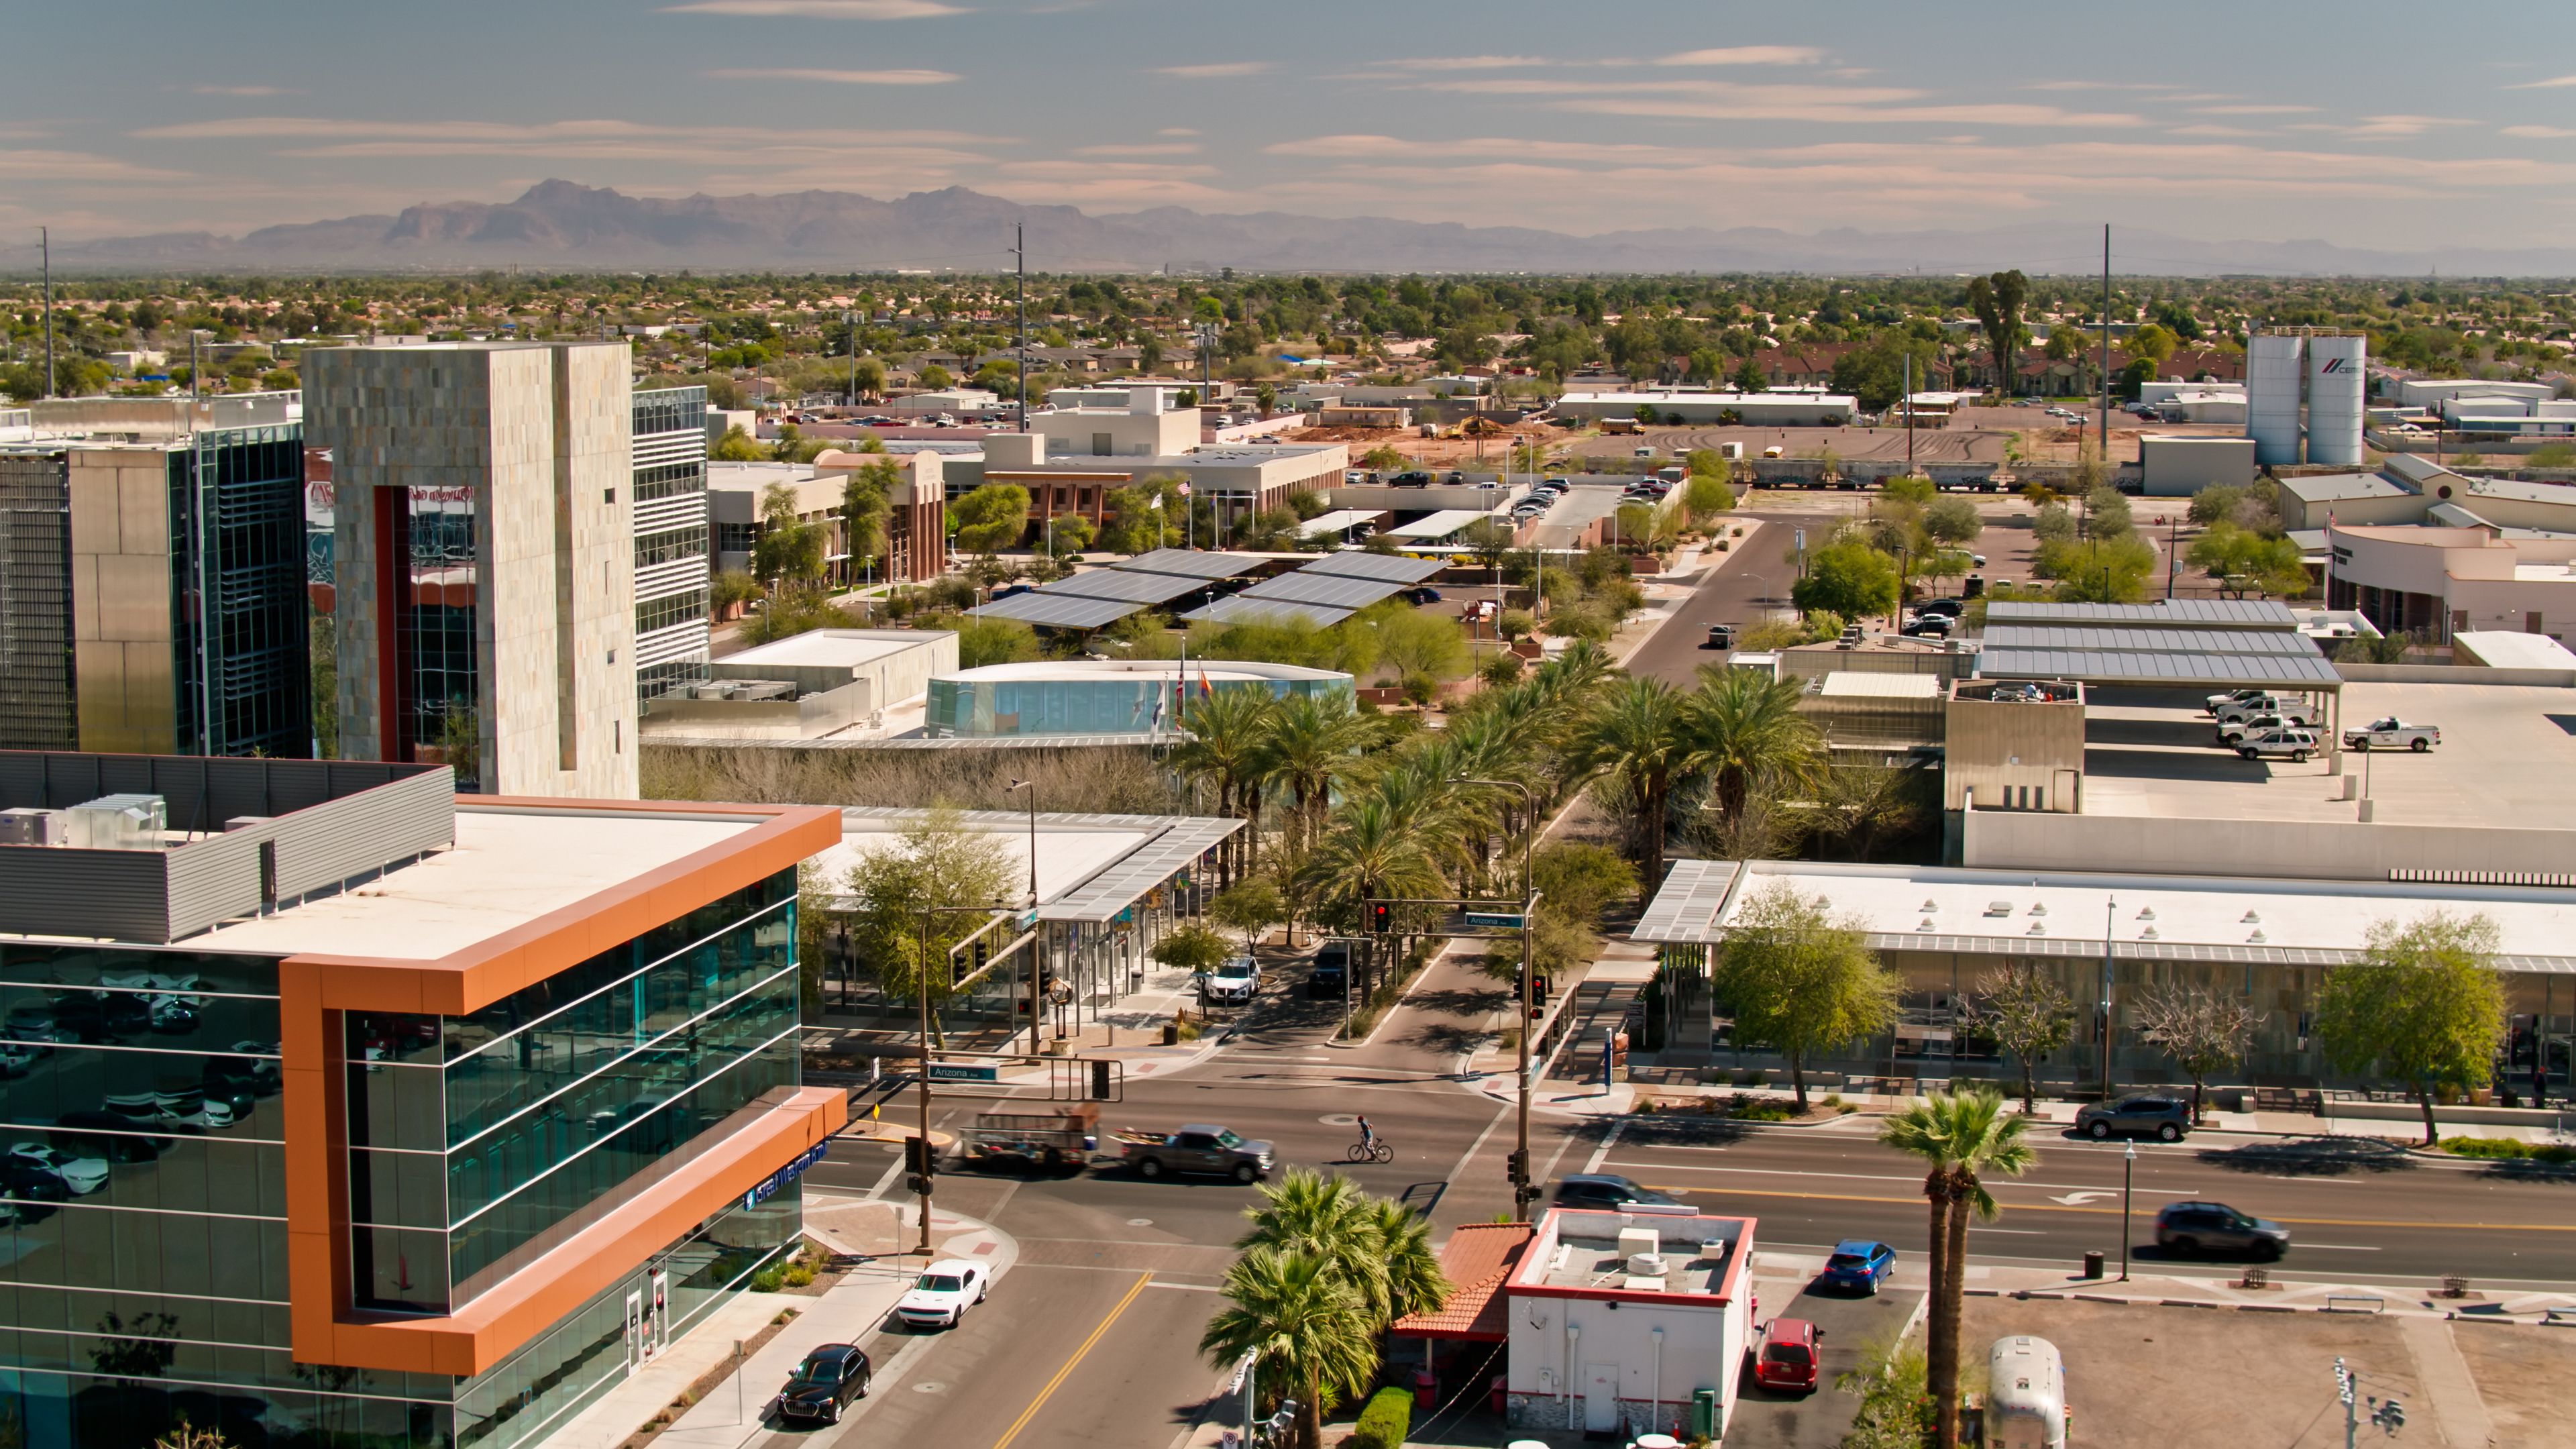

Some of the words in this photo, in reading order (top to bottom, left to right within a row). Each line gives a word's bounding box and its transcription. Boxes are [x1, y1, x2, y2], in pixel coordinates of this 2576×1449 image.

[934, 1067, 967, 1077] Arizona
[756, 1174, 778, 1202] Great
[779, 1152, 810, 1186] Western
[810, 1139, 828, 1165] Bank
